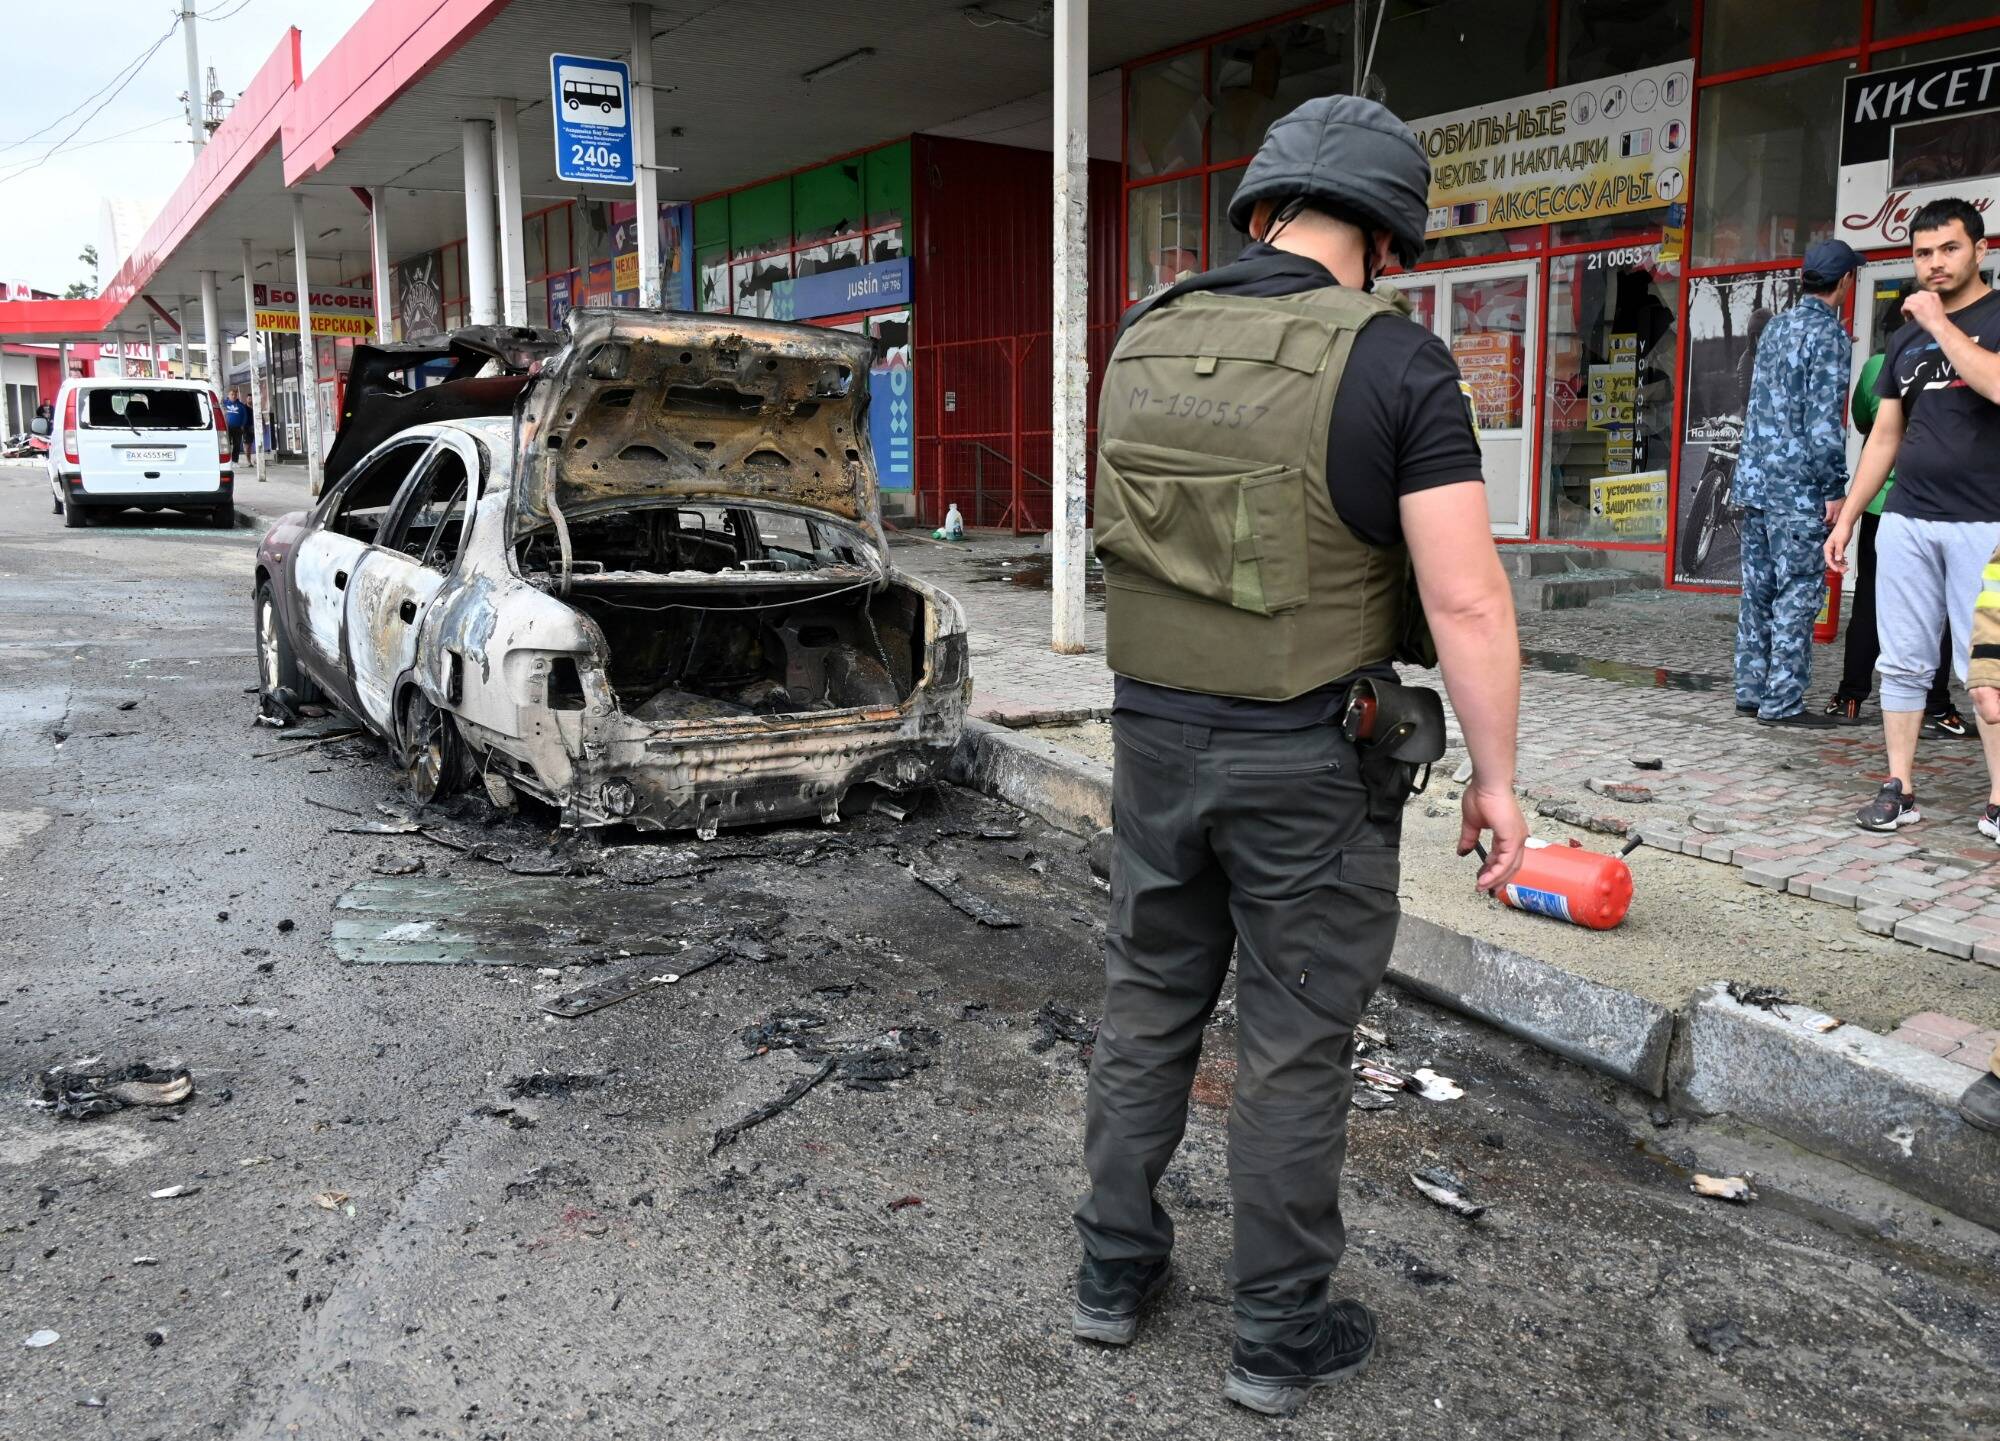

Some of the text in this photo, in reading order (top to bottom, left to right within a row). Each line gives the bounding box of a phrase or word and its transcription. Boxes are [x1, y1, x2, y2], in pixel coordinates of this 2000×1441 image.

[1854, 61, 2000, 124] КИСЕТ
[571, 144, 621, 168] 240е
[1434, 136, 1609, 190] ЧЕХЛЫ И НАКЛАДКИ
[1490, 173, 1654, 224] АКСЕССУАРЫ
[1587, 252, 1602, 270] 21
[271, 289, 373, 309] БОИСФЕН
[847, 271, 878, 301] justin
[255, 314, 362, 333] АРИКМХЕРСКАЯ
[1129, 387, 1270, 429] M-190557
